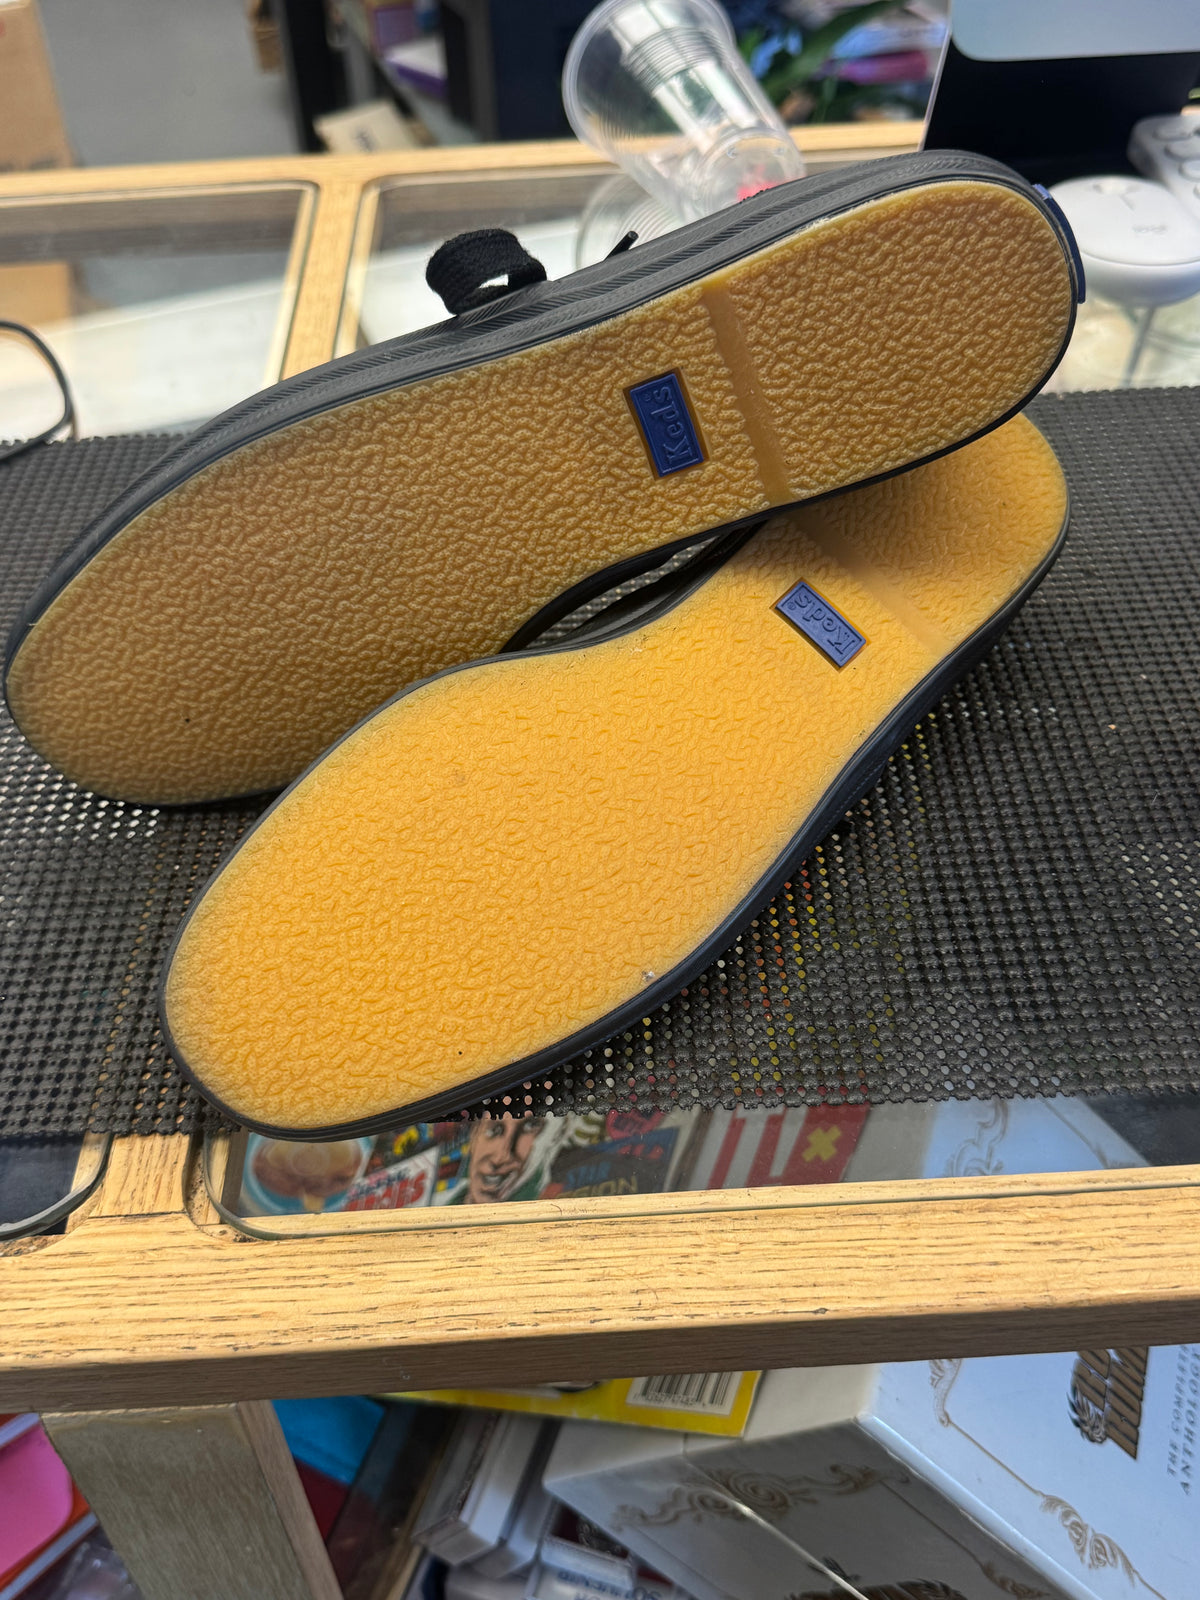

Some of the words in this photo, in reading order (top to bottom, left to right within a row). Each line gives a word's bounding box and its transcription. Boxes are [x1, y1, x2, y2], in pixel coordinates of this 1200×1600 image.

[651, 386, 693, 465] Keds
[794, 593, 855, 655] Keds
[1167, 1438, 1178, 1477] THE
